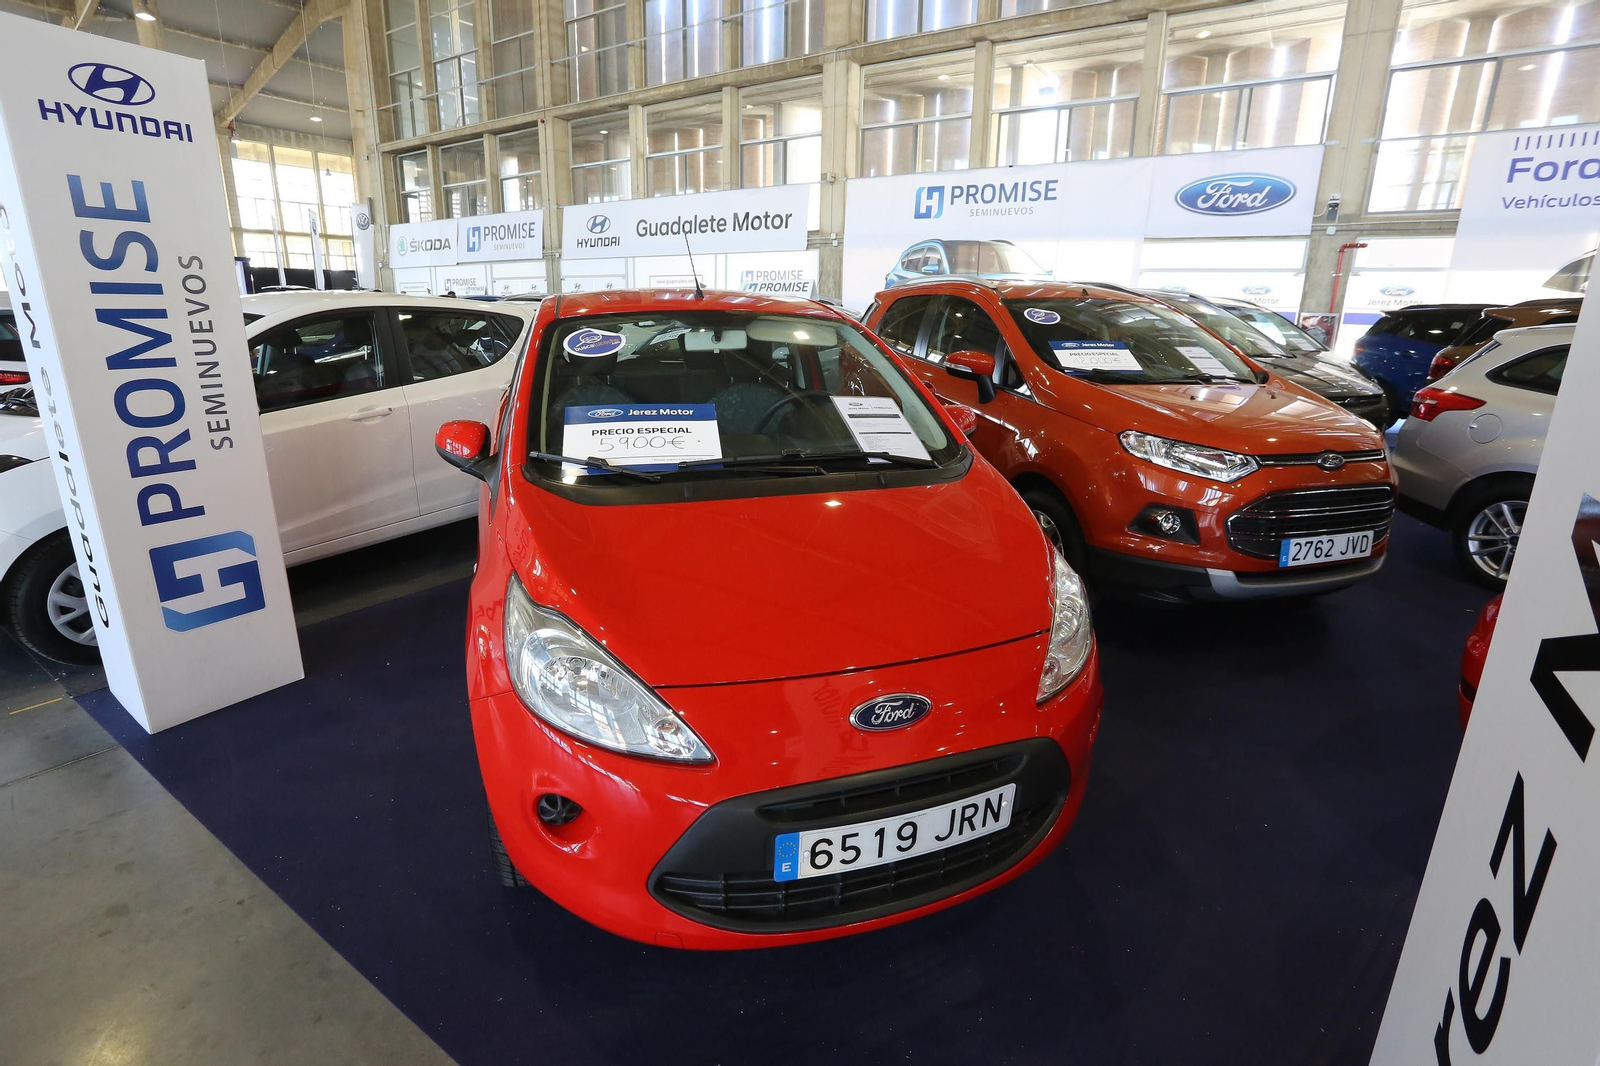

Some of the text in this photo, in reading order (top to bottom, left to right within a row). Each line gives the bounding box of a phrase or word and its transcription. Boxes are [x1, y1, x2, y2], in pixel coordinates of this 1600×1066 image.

[38, 99, 193, 142] HYUNDAI
[950, 179, 1058, 206] PROMISE
[1197, 178, 1272, 209] Ford
[1502, 193, 1600, 209] Vehículos
[969, 206, 1034, 218] SEMINUEVOS
[483, 222, 536, 242] PROMISE
[636, 211, 792, 238] Guadalete Motor
[409, 237, 451, 253] ŠKODA
[493, 243, 526, 251] SEMINUEVOS
[577, 236, 620, 248] HYUNDAI
[451, 277, 477, 287] PROMISE
[756, 269, 804, 282] PROMISE
[759, 282, 810, 293] PROMISE
[1367, 298, 1392, 306] Jerez
[67, 174, 205, 526] PROMISE
[178, 255, 234, 451] SEMINUEVOS
[660, 408, 694, 416] Motor
[591, 427, 692, 436] PRECIO ESPECIAL
[40, 366, 109, 628] Guadalete
[1291, 538, 1335, 561] 2762
[1340, 534, 1370, 555] JVD
[871, 700, 915, 725] Ford
[781, 793, 1004, 873] E 6519 JRN
